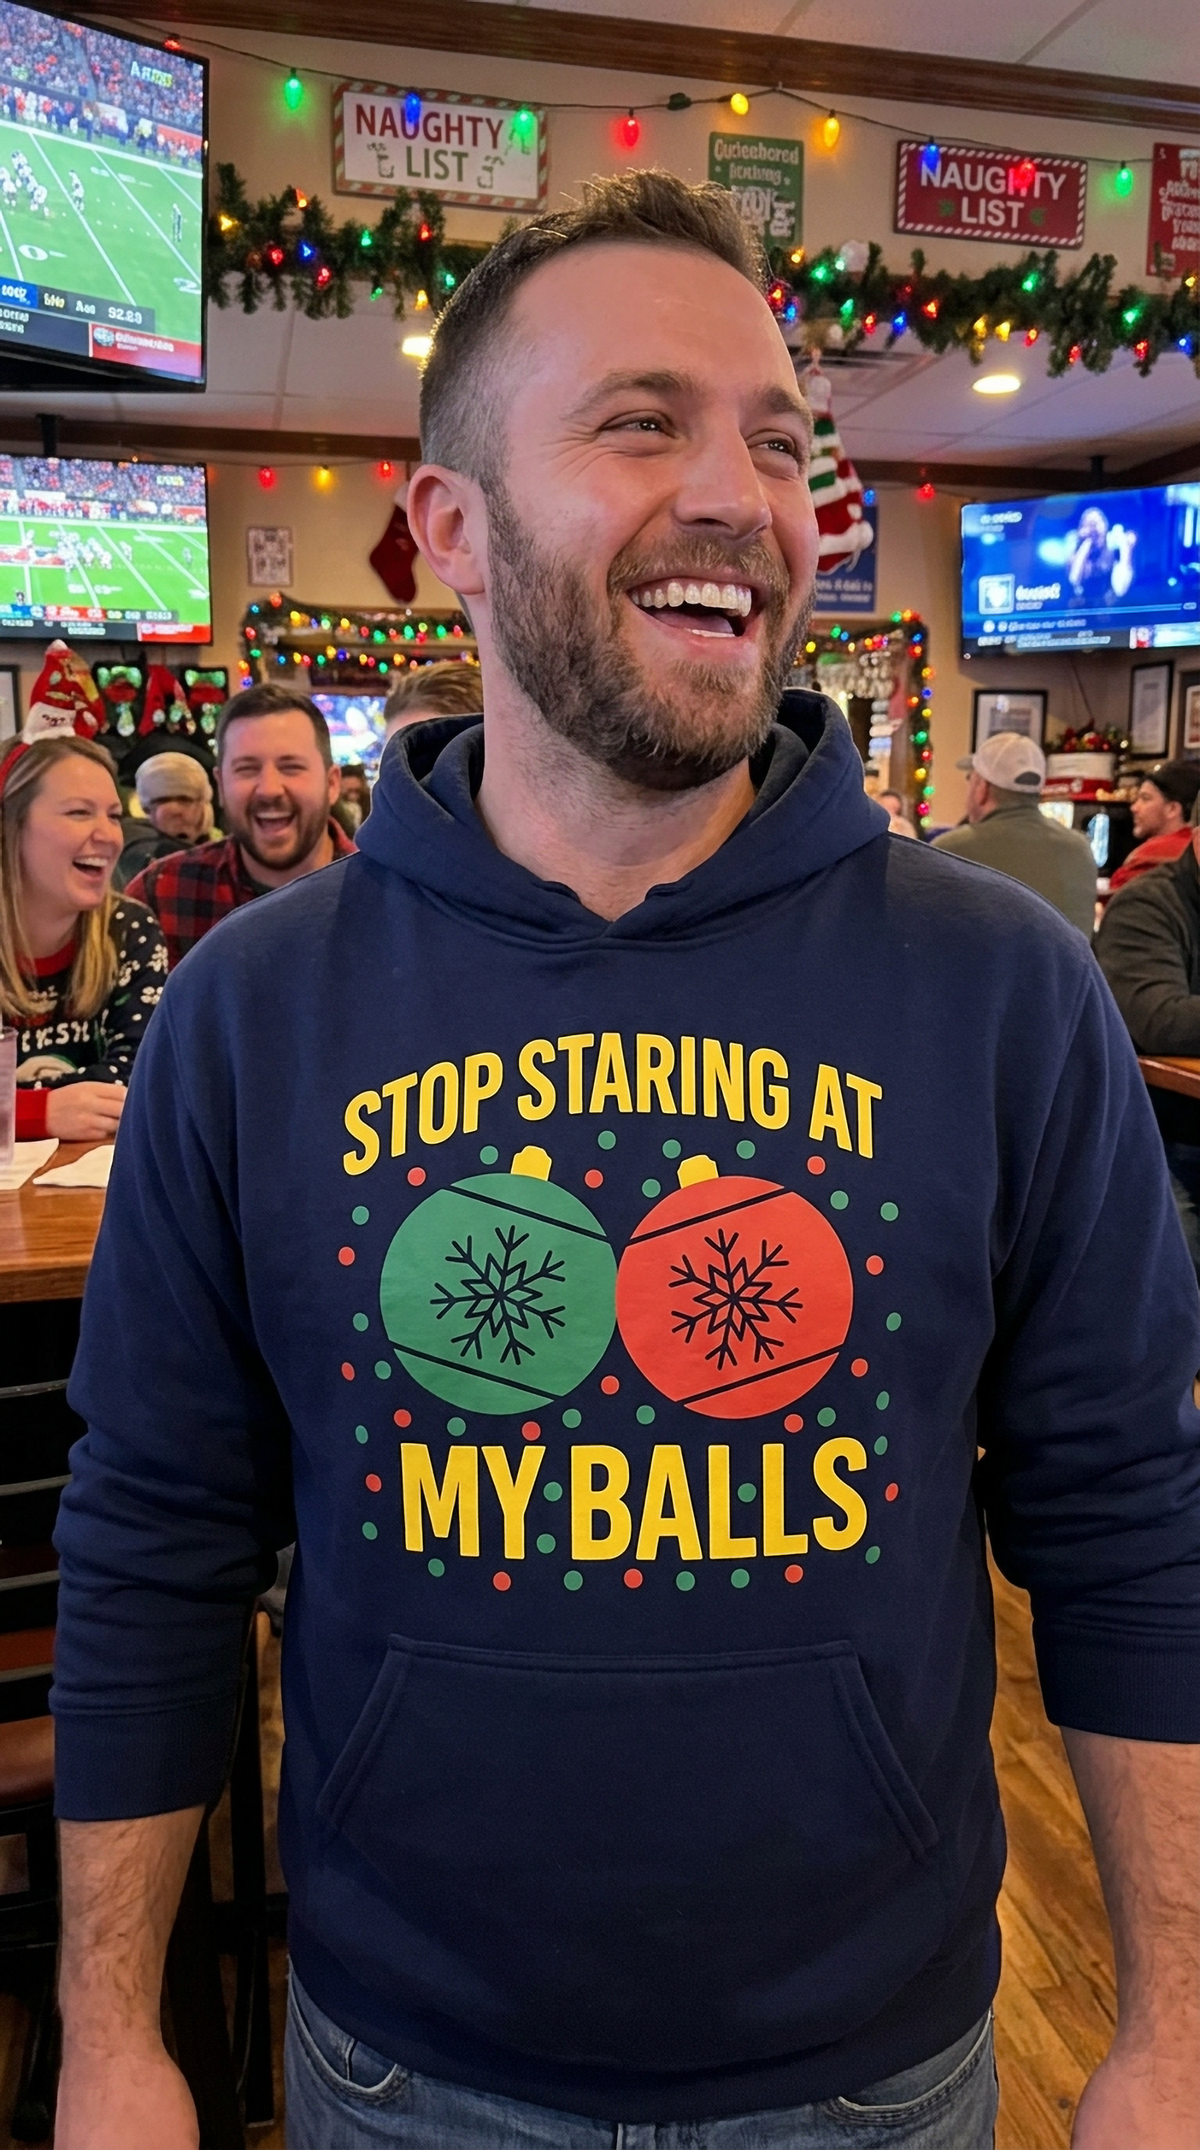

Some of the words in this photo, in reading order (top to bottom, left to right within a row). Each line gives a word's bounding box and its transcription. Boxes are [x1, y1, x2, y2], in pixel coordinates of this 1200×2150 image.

[355, 103, 504, 151] NAUGHTY
[406, 145, 470, 183] LIST
[920, 159, 1067, 201] NAUGHTY
[960, 196, 1025, 229] LIST
[343, 1051, 504, 1176] STOP
[516, 1032, 791, 1131] STARING
[808, 1063, 884, 1159] AT
[400, 1442, 546, 1559] MY
[570, 1436, 869, 1560] BALLS
